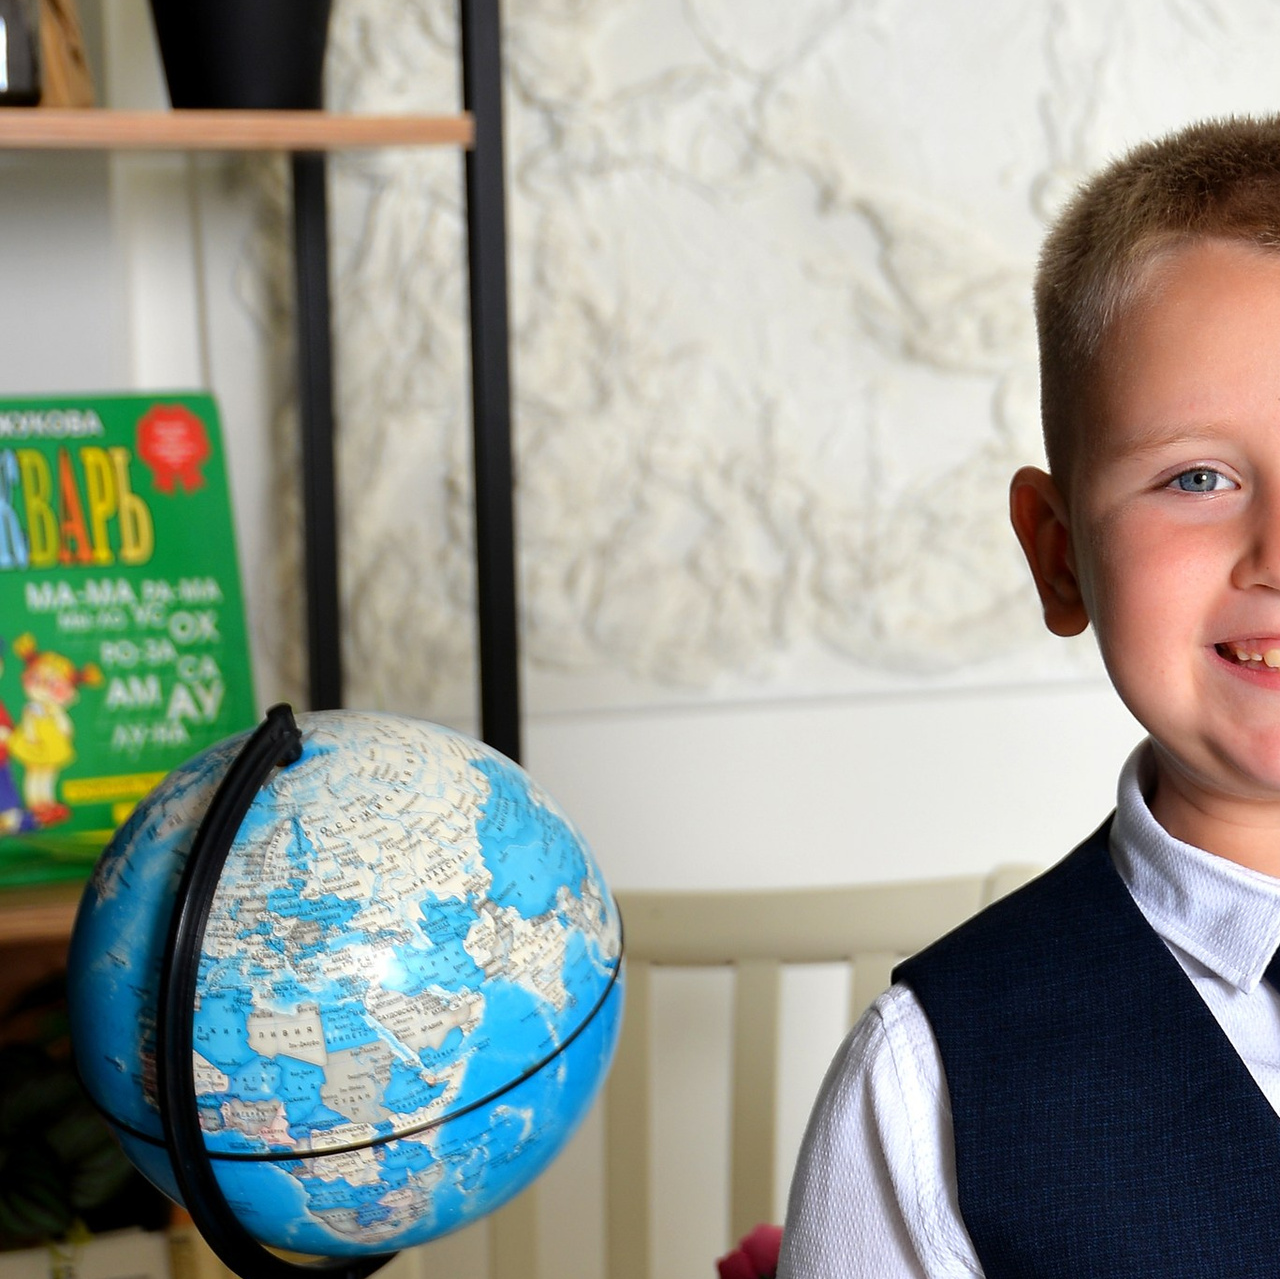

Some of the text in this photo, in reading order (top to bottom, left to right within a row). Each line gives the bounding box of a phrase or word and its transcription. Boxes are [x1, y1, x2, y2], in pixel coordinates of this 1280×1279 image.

[168, 610, 219, 645] ОХ
[106, 674, 224, 724] АМ АУ
[258, 1025, 313, 1039] ЛИВИЯ
[333, 1092, 371, 1106] СУДАН
